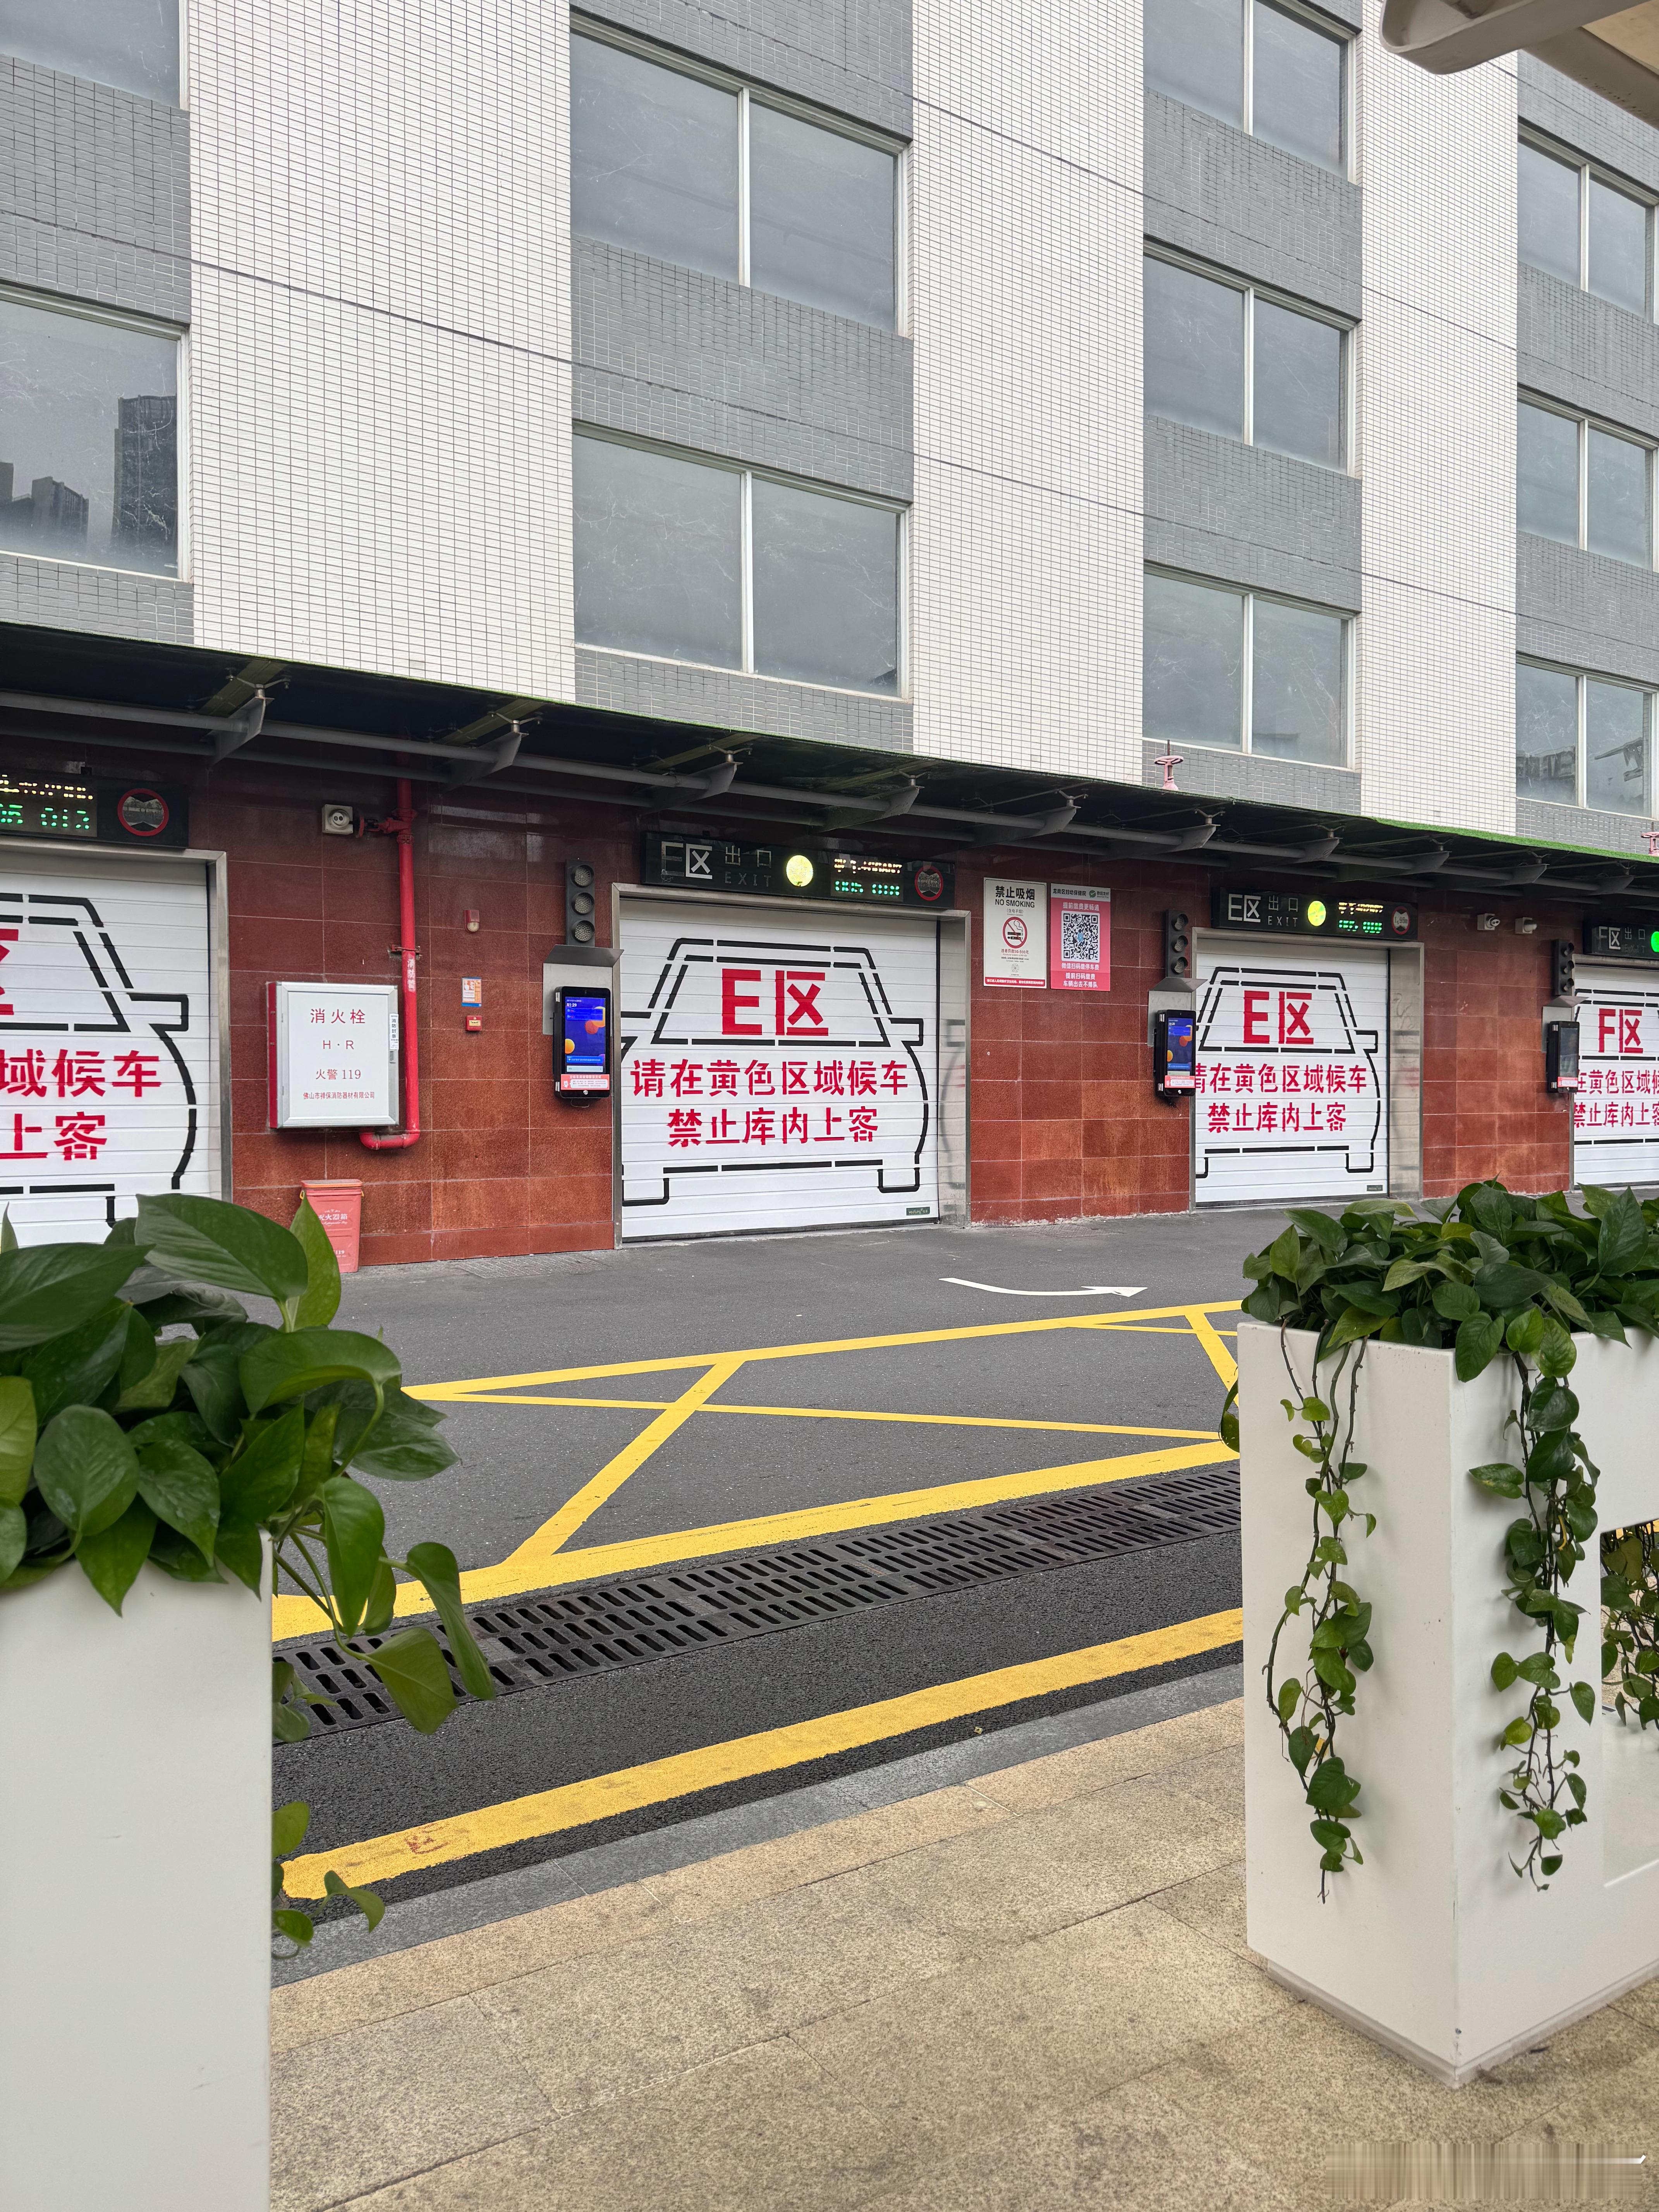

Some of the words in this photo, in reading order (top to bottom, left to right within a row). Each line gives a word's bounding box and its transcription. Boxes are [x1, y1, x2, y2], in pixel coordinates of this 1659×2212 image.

[725, 845, 771, 868] 出口
[725, 872, 771, 887] EXIT
[995, 885, 1035, 900] 禁止吸烟
[1006, 900, 1035, 908] SMOKING
[1268, 895, 1298, 912] 出口
[1228, 893, 1261, 922] E区
[1268, 916, 1298, 927] EXIT
[1599, 926, 1621, 950] F区
[1625, 927, 1645, 940] 出口
[722, 969, 829, 1036] E区
[310, 1008, 365, 1024] 消火栓
[1243, 990, 1314, 1044] E区
[1599, 1008, 1644, 1053] F区
[630, 1059, 908, 1097] 请在黄色区域候车
[668, 1106, 878, 1147] 禁止库内上客
[1207, 1102, 1346, 1133] 禁止库内上客
